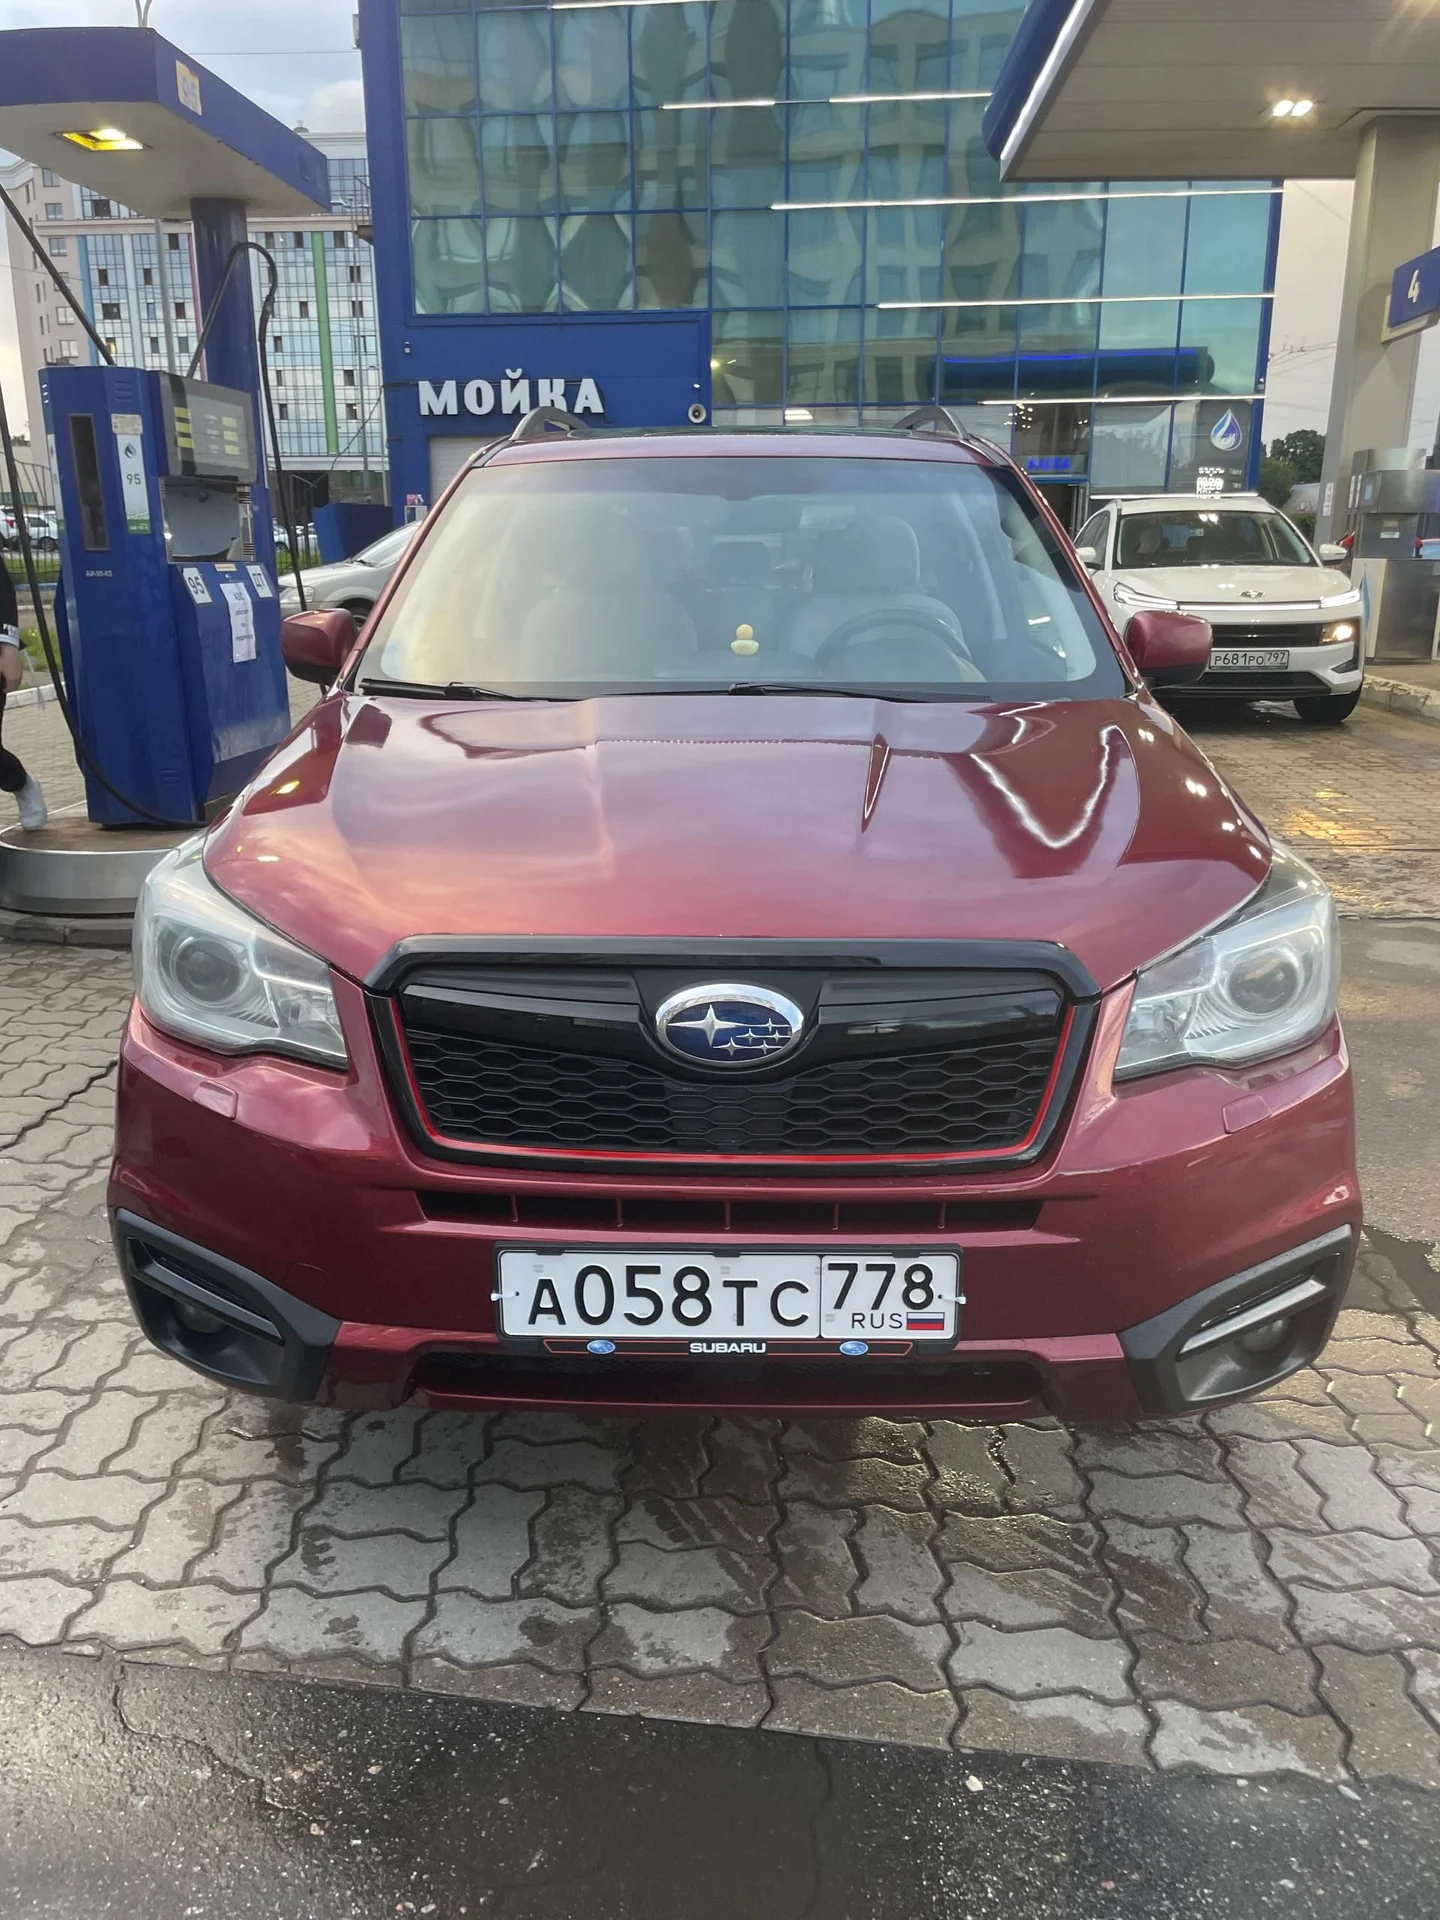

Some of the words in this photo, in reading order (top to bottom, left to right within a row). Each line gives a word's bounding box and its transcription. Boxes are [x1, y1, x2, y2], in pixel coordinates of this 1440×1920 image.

[1407, 269, 1420, 303] 4
[417, 367, 604, 416] МОЙКА
[126, 473, 142, 485] 95
[187, 576, 205, 595] 95
[1214, 653, 1264, 665] Р681РО
[1267, 652, 1286, 662] 797
[527, 1264, 810, 1327] А058ТС
[828, 1262, 936, 1311] 778
[851, 1313, 903, 1330] RUS
[689, 1342, 766, 1354] SUBARU
